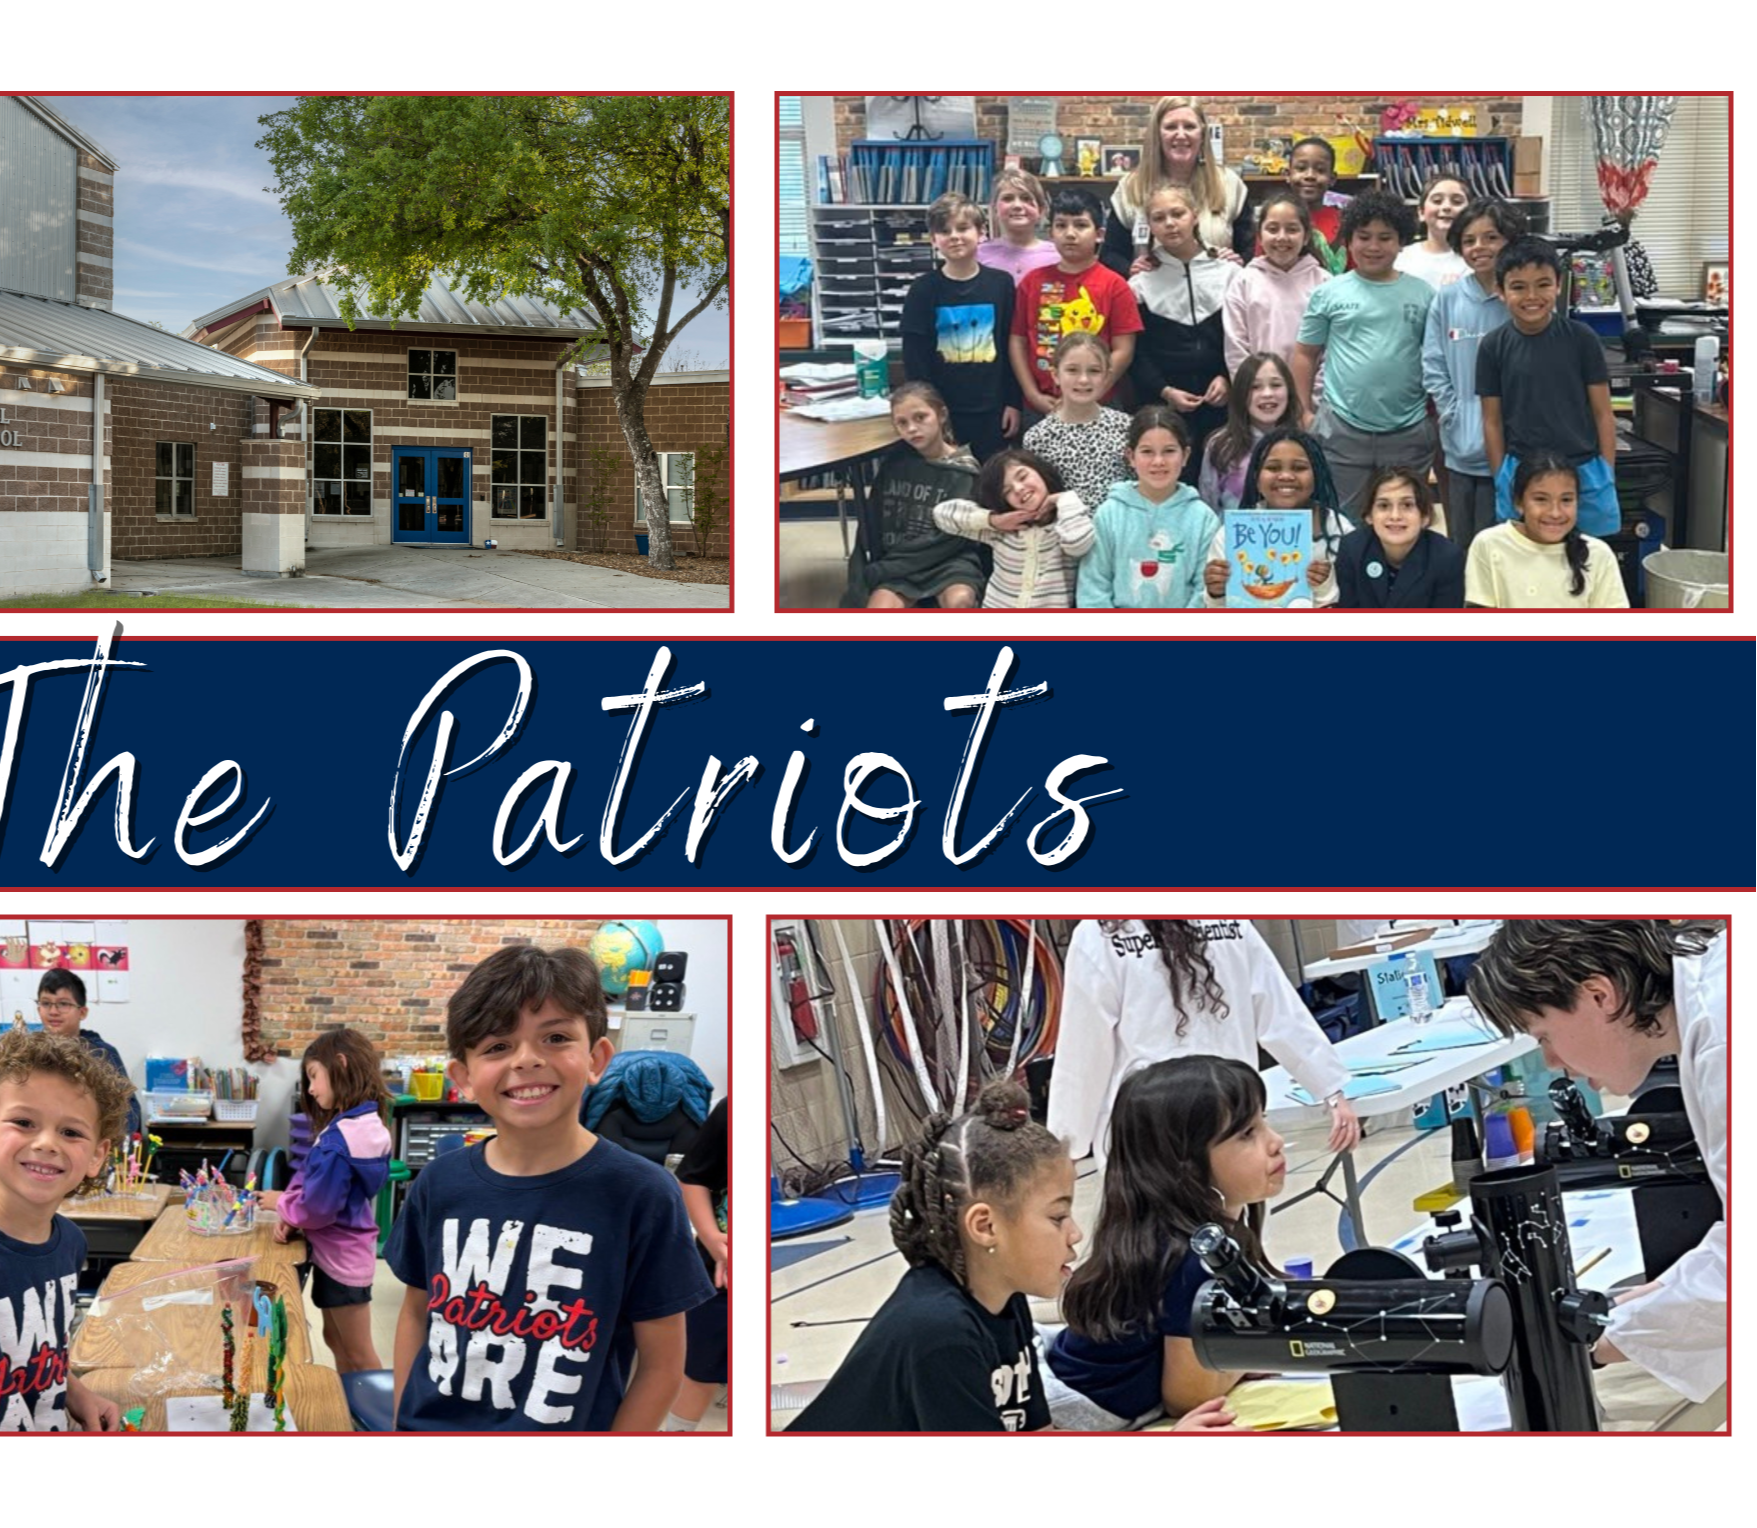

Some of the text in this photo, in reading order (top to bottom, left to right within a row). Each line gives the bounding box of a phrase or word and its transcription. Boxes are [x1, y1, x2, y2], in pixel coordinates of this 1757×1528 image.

[1233, 523, 1257, 549] Be
[1111, 934, 1162, 958] Supe
[442, 1218, 593, 1320] WE
[427, 1273, 599, 1351] Patriots
[428, 1312, 591, 1424] ARE
